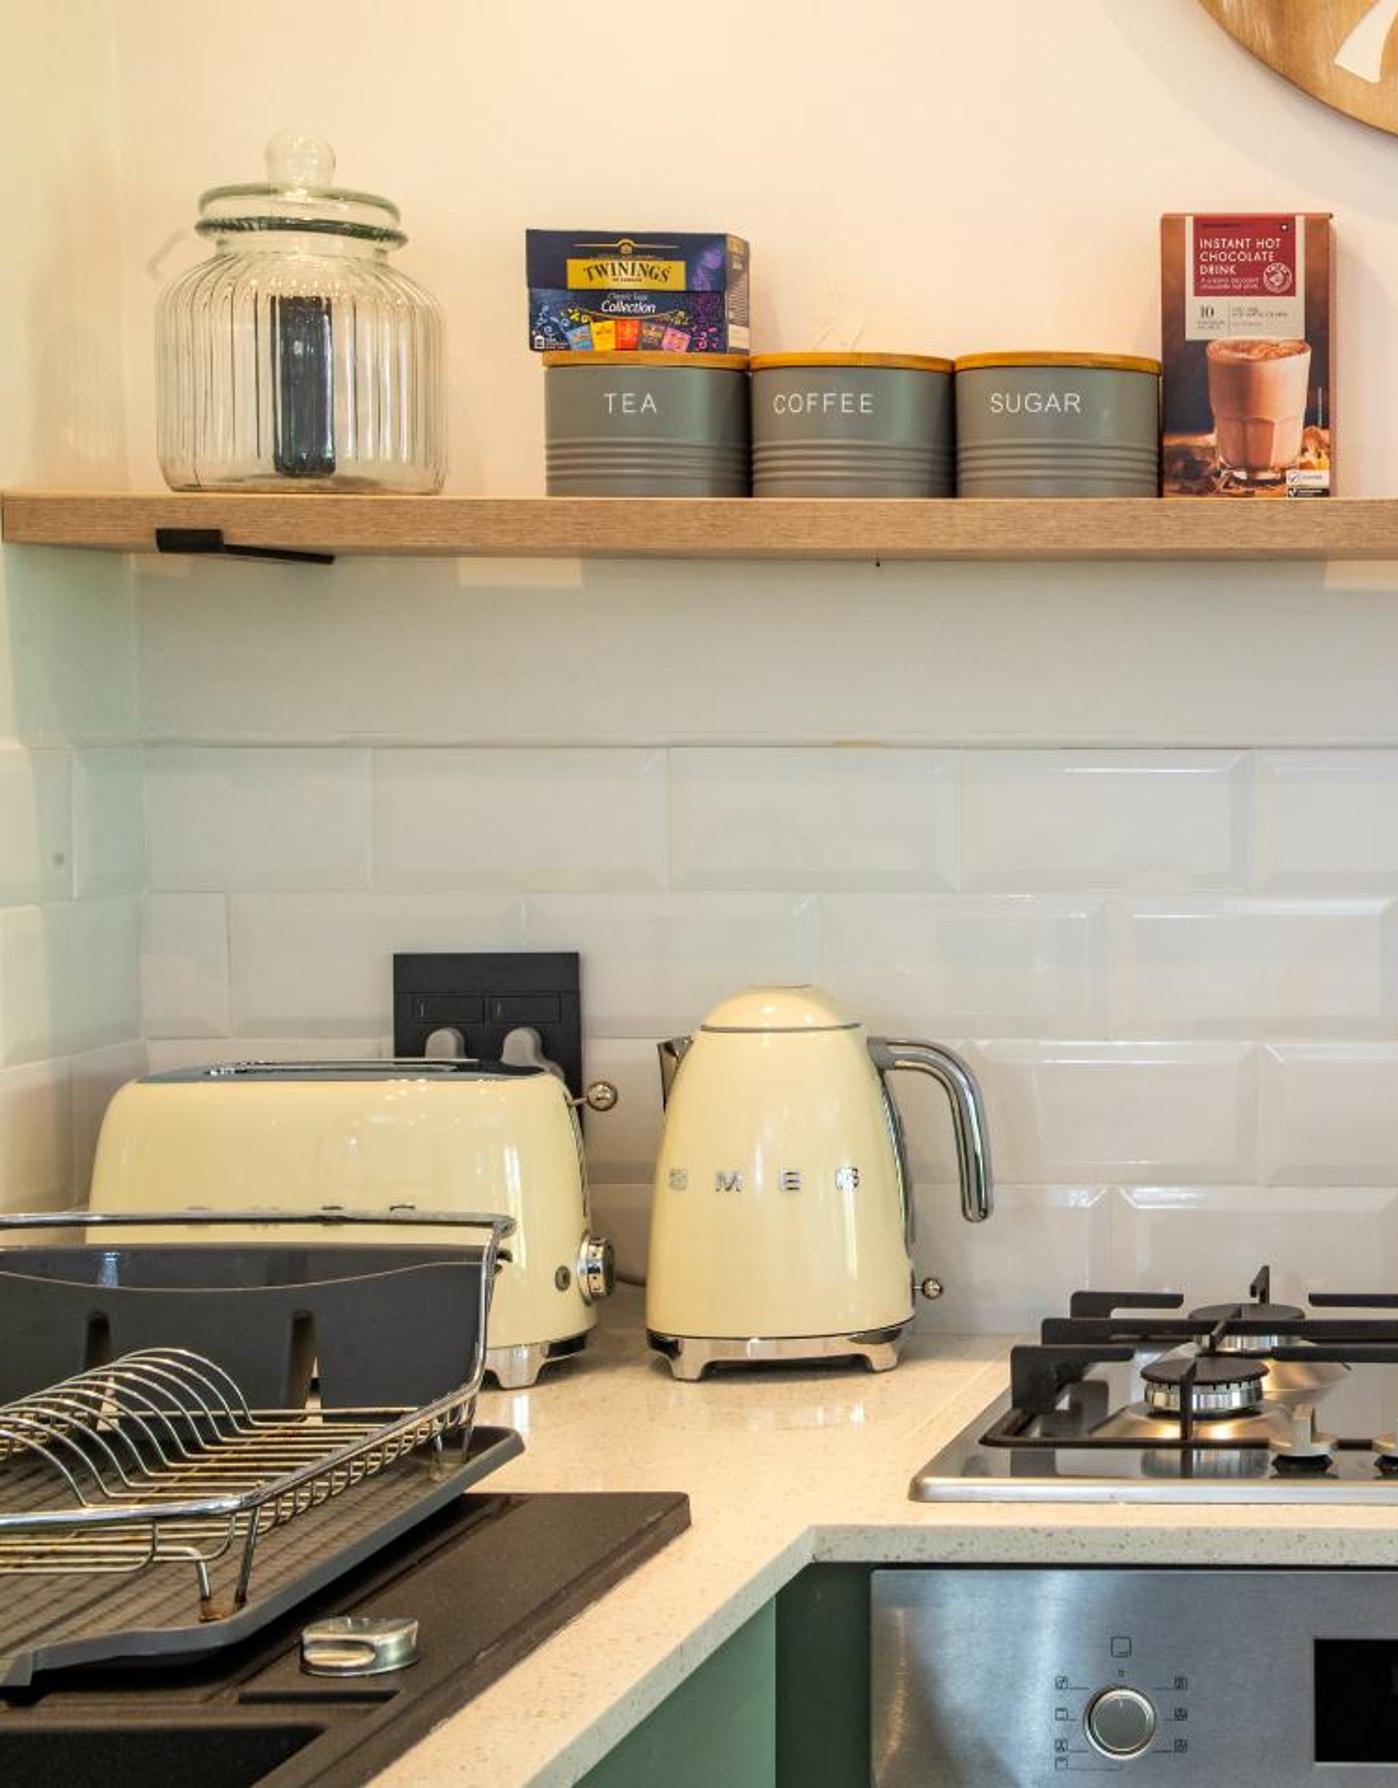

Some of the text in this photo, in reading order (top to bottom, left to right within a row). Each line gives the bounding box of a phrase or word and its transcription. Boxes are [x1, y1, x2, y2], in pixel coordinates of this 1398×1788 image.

[1199, 238, 1282, 249] INSTANT HOT
[1199, 251, 1275, 262] CHOCOLATE
[584, 261, 671, 283] TWININGS
[1199, 264, 1237, 275] DRINK
[602, 300, 657, 314] Collection
[603, 392, 658, 415] TEA
[772, 392, 875, 415] COFFEE
[989, 392, 1082, 415] SUGAR
[668, 1167, 861, 1193] SMEG
